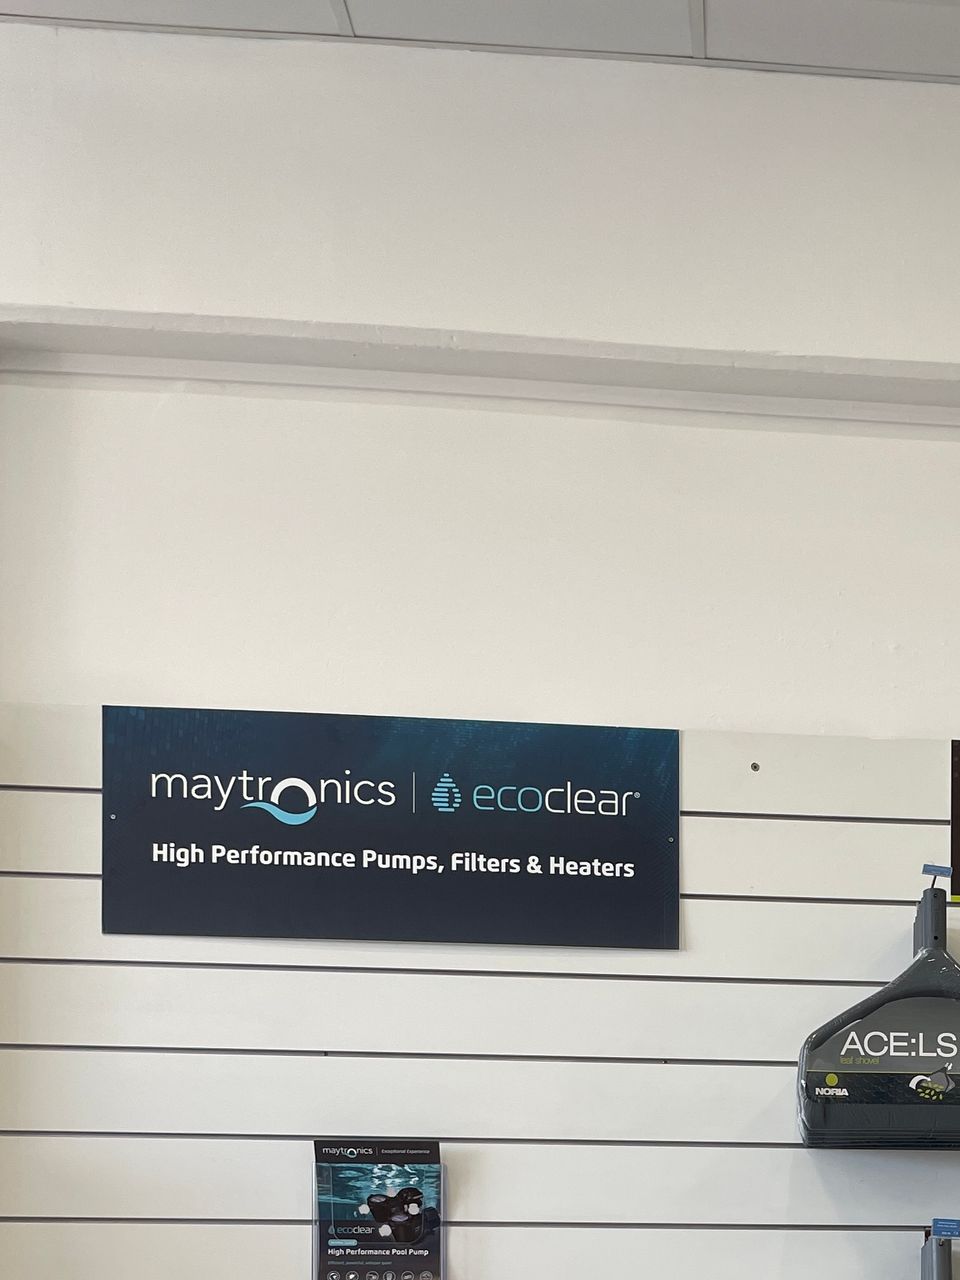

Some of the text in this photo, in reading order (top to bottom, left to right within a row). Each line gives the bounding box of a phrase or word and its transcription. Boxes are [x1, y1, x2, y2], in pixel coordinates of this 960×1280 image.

[151, 769, 396, 825] maytronics
[152, 843, 635, 878] High Performance Pumps, Filters & Heaters
[840, 1031, 958, 1058] ACE:LS
[815, 1087, 849, 1097] NORIA
[323, 1147, 373, 1158] maytronics
[328, 1249, 344, 1257] High
[409, 1249, 429, 1257] Pump
